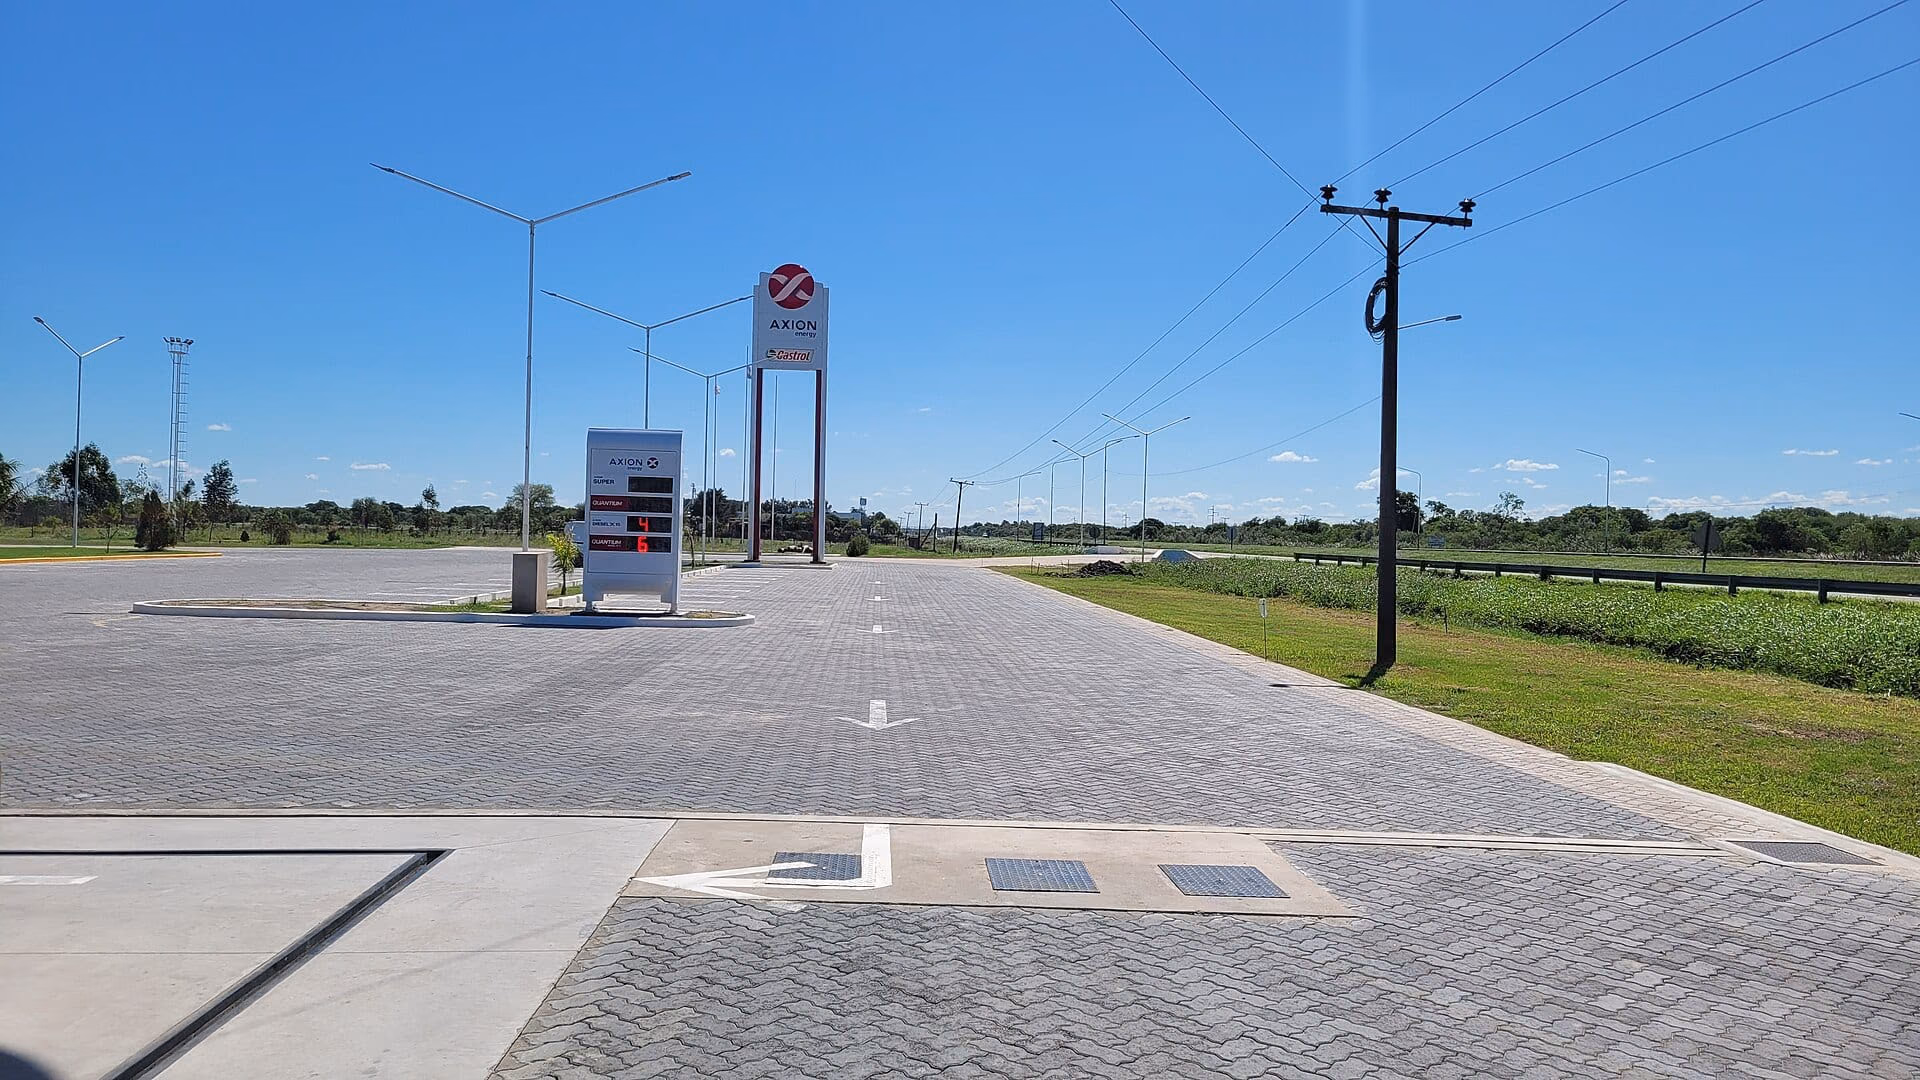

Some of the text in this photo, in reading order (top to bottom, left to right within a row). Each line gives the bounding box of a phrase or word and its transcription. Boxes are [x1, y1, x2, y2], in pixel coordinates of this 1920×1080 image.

[769, 319, 817, 331] AXION
[776, 350, 811, 361] Castrol
[609, 458, 643, 466] AXION
[638, 517, 649, 532] 4
[637, 536, 649, 553] 6
